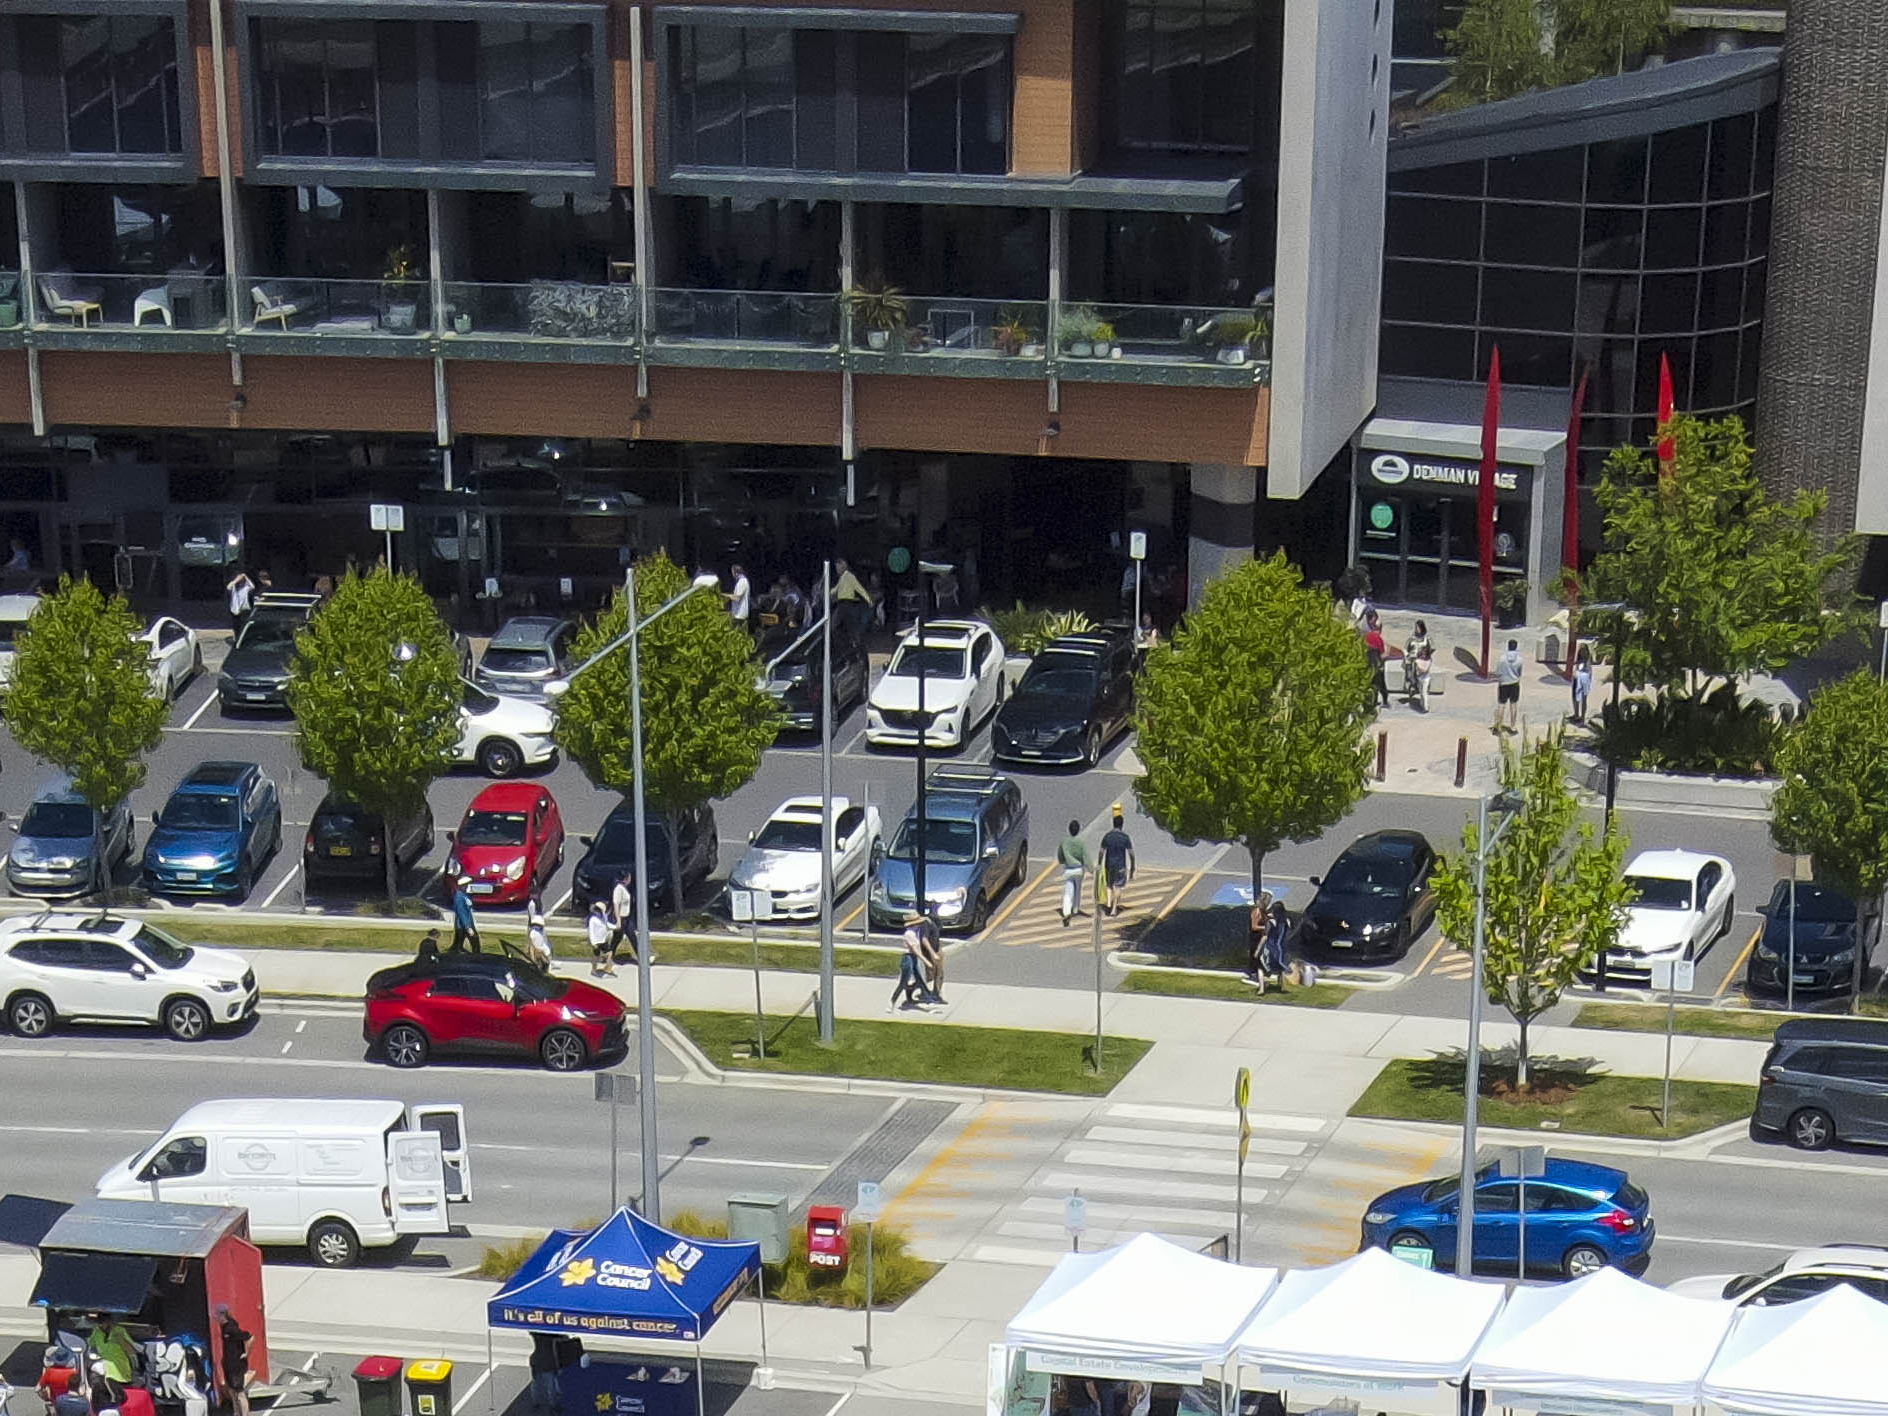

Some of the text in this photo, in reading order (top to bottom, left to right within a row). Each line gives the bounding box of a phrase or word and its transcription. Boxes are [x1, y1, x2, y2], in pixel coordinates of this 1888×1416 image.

[1413, 464, 1518, 489] DENMAN VIAGE
[809, 1252, 840, 1265] POST
[600, 1260, 653, 1279] Cancer
[596, 1274, 651, 1291] Council
[504, 1309, 525, 1322] It's
[527, 1310, 544, 1324] all
[546, 1311, 561, 1325] of
[563, 1315, 578, 1327] us
[580, 1315, 631, 1330] against
